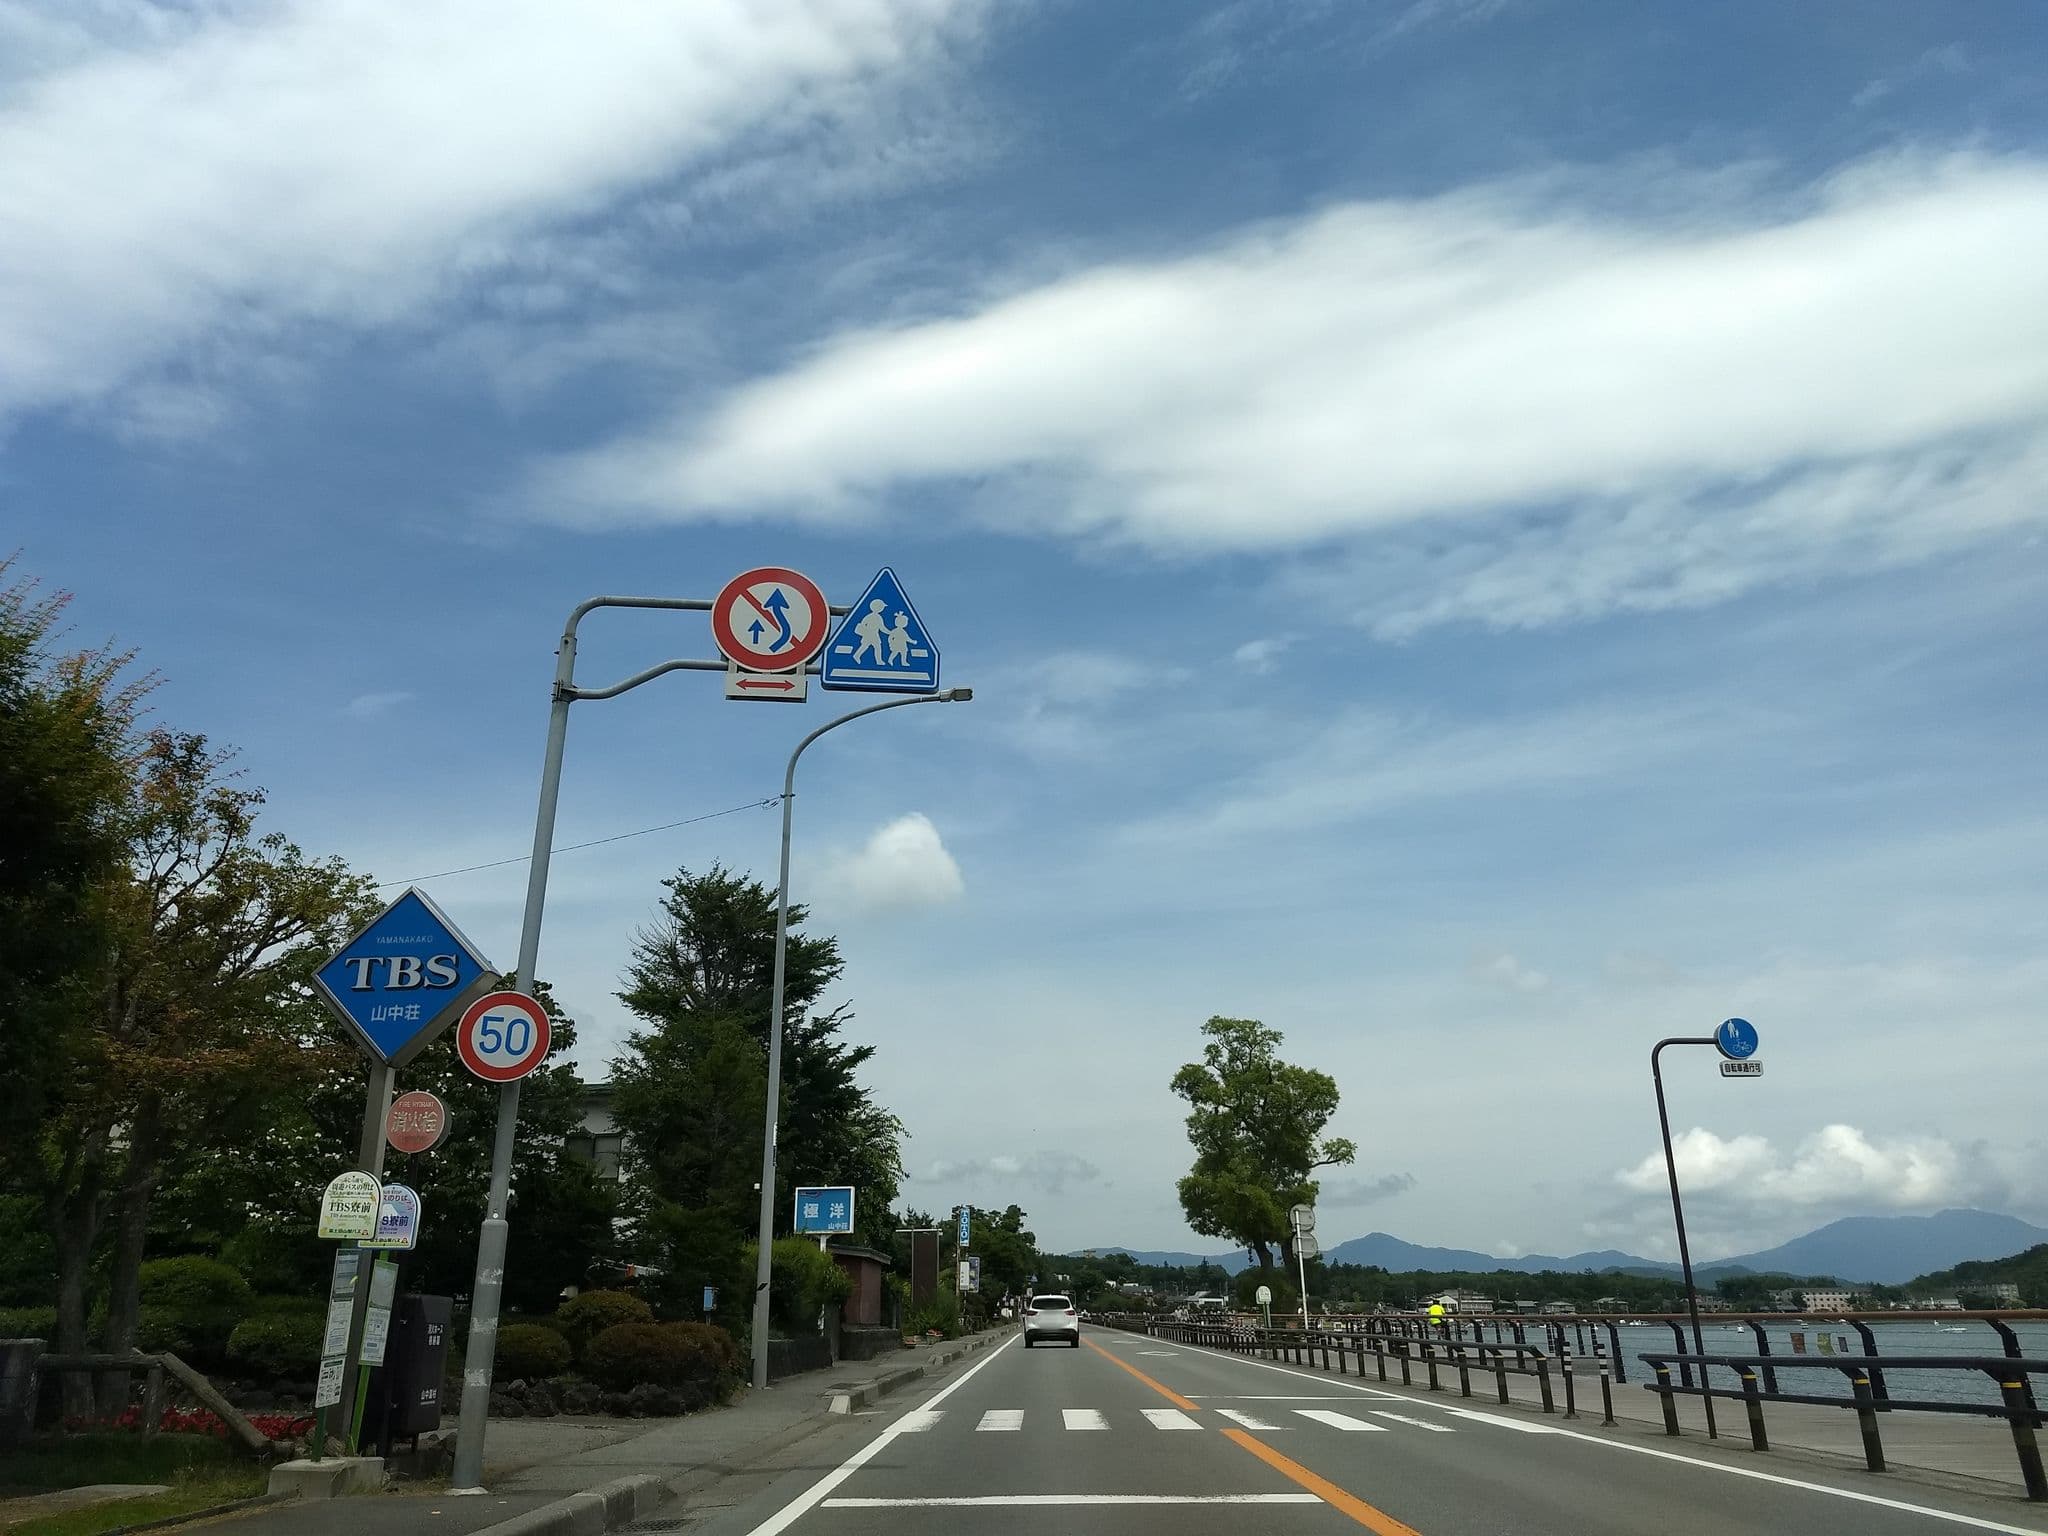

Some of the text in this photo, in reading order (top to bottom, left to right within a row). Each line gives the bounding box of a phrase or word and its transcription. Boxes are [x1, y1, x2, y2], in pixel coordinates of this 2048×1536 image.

[376, 935, 433, 944] YAMANAKAKO
[345, 954, 459, 990] TBS
[371, 1004, 421, 1022] 山中荘
[479, 1015, 531, 1056] 50
[391, 1111, 438, 1133] 消火栓
